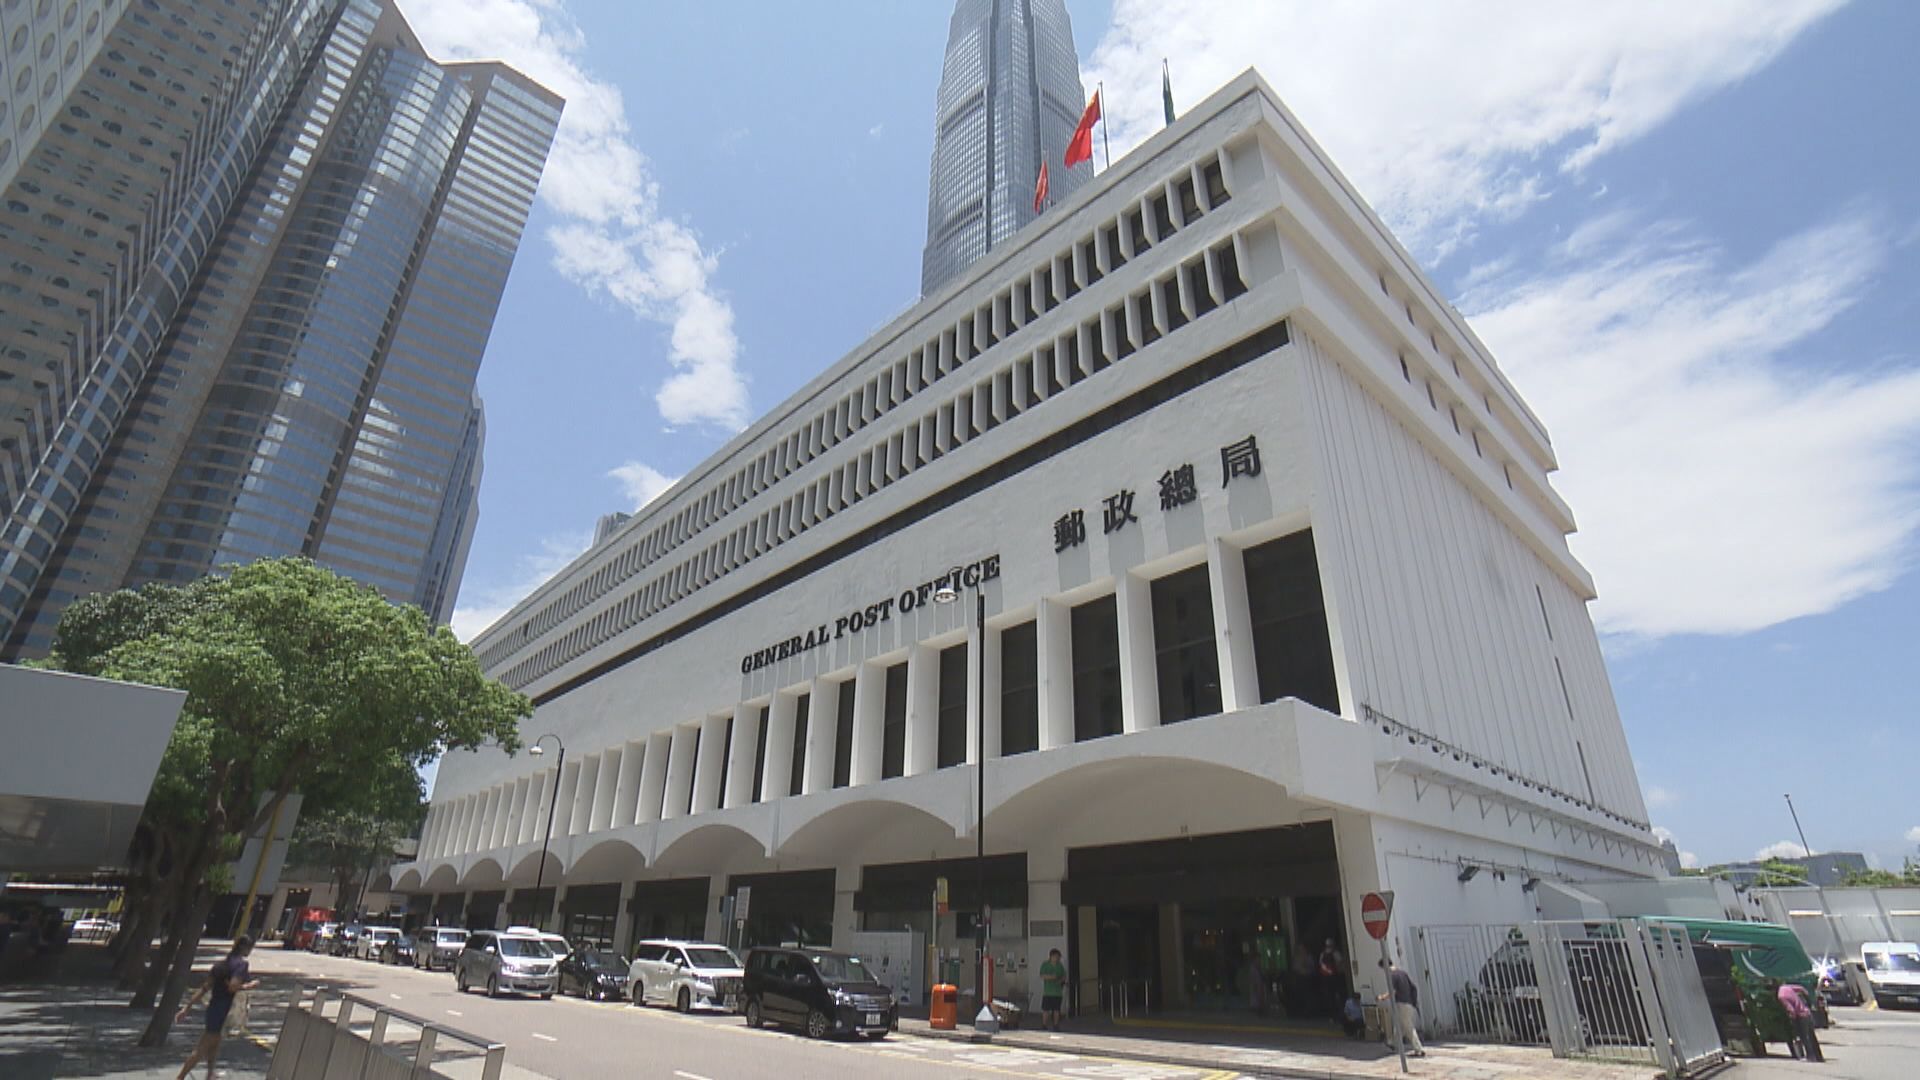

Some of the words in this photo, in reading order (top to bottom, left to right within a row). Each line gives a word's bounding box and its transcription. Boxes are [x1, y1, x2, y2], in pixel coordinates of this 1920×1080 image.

[1054, 435, 1261, 553] 郵政總局
[741, 625, 830, 674] GENERAL
[834, 598, 894, 639] POST
[899, 554, 1000, 613] OFFICE
